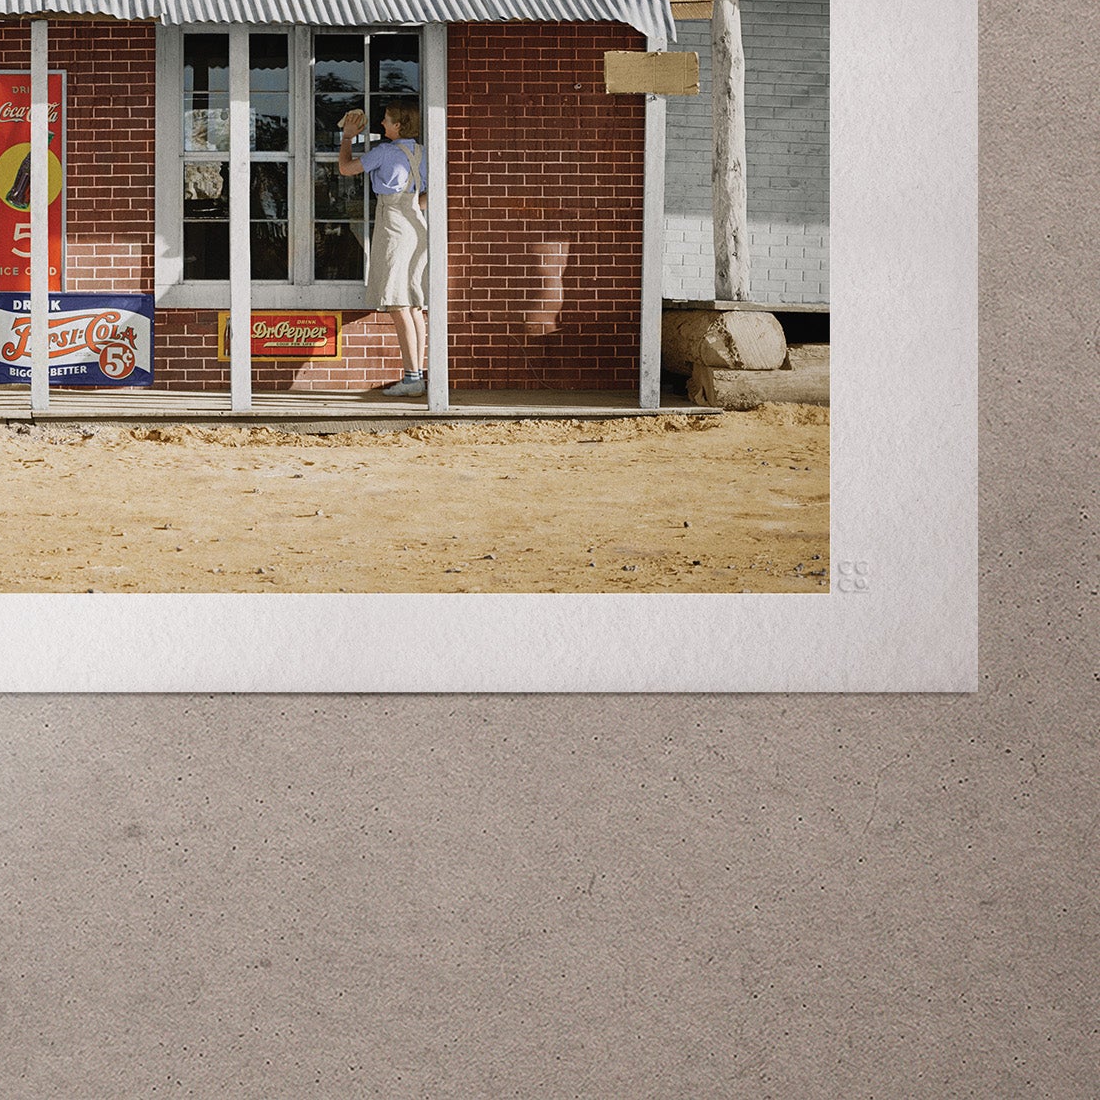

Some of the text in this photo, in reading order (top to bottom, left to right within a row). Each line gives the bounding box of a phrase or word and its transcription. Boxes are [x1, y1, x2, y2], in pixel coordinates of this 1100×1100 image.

[12, 85, 30, 94] DRI
[0, 266, 57, 276] ICE CD
[12, 300, 61, 311] DRK
[104, 346, 133, 376] 5¢
[9, 365, 88, 378] BIGG BETTER
